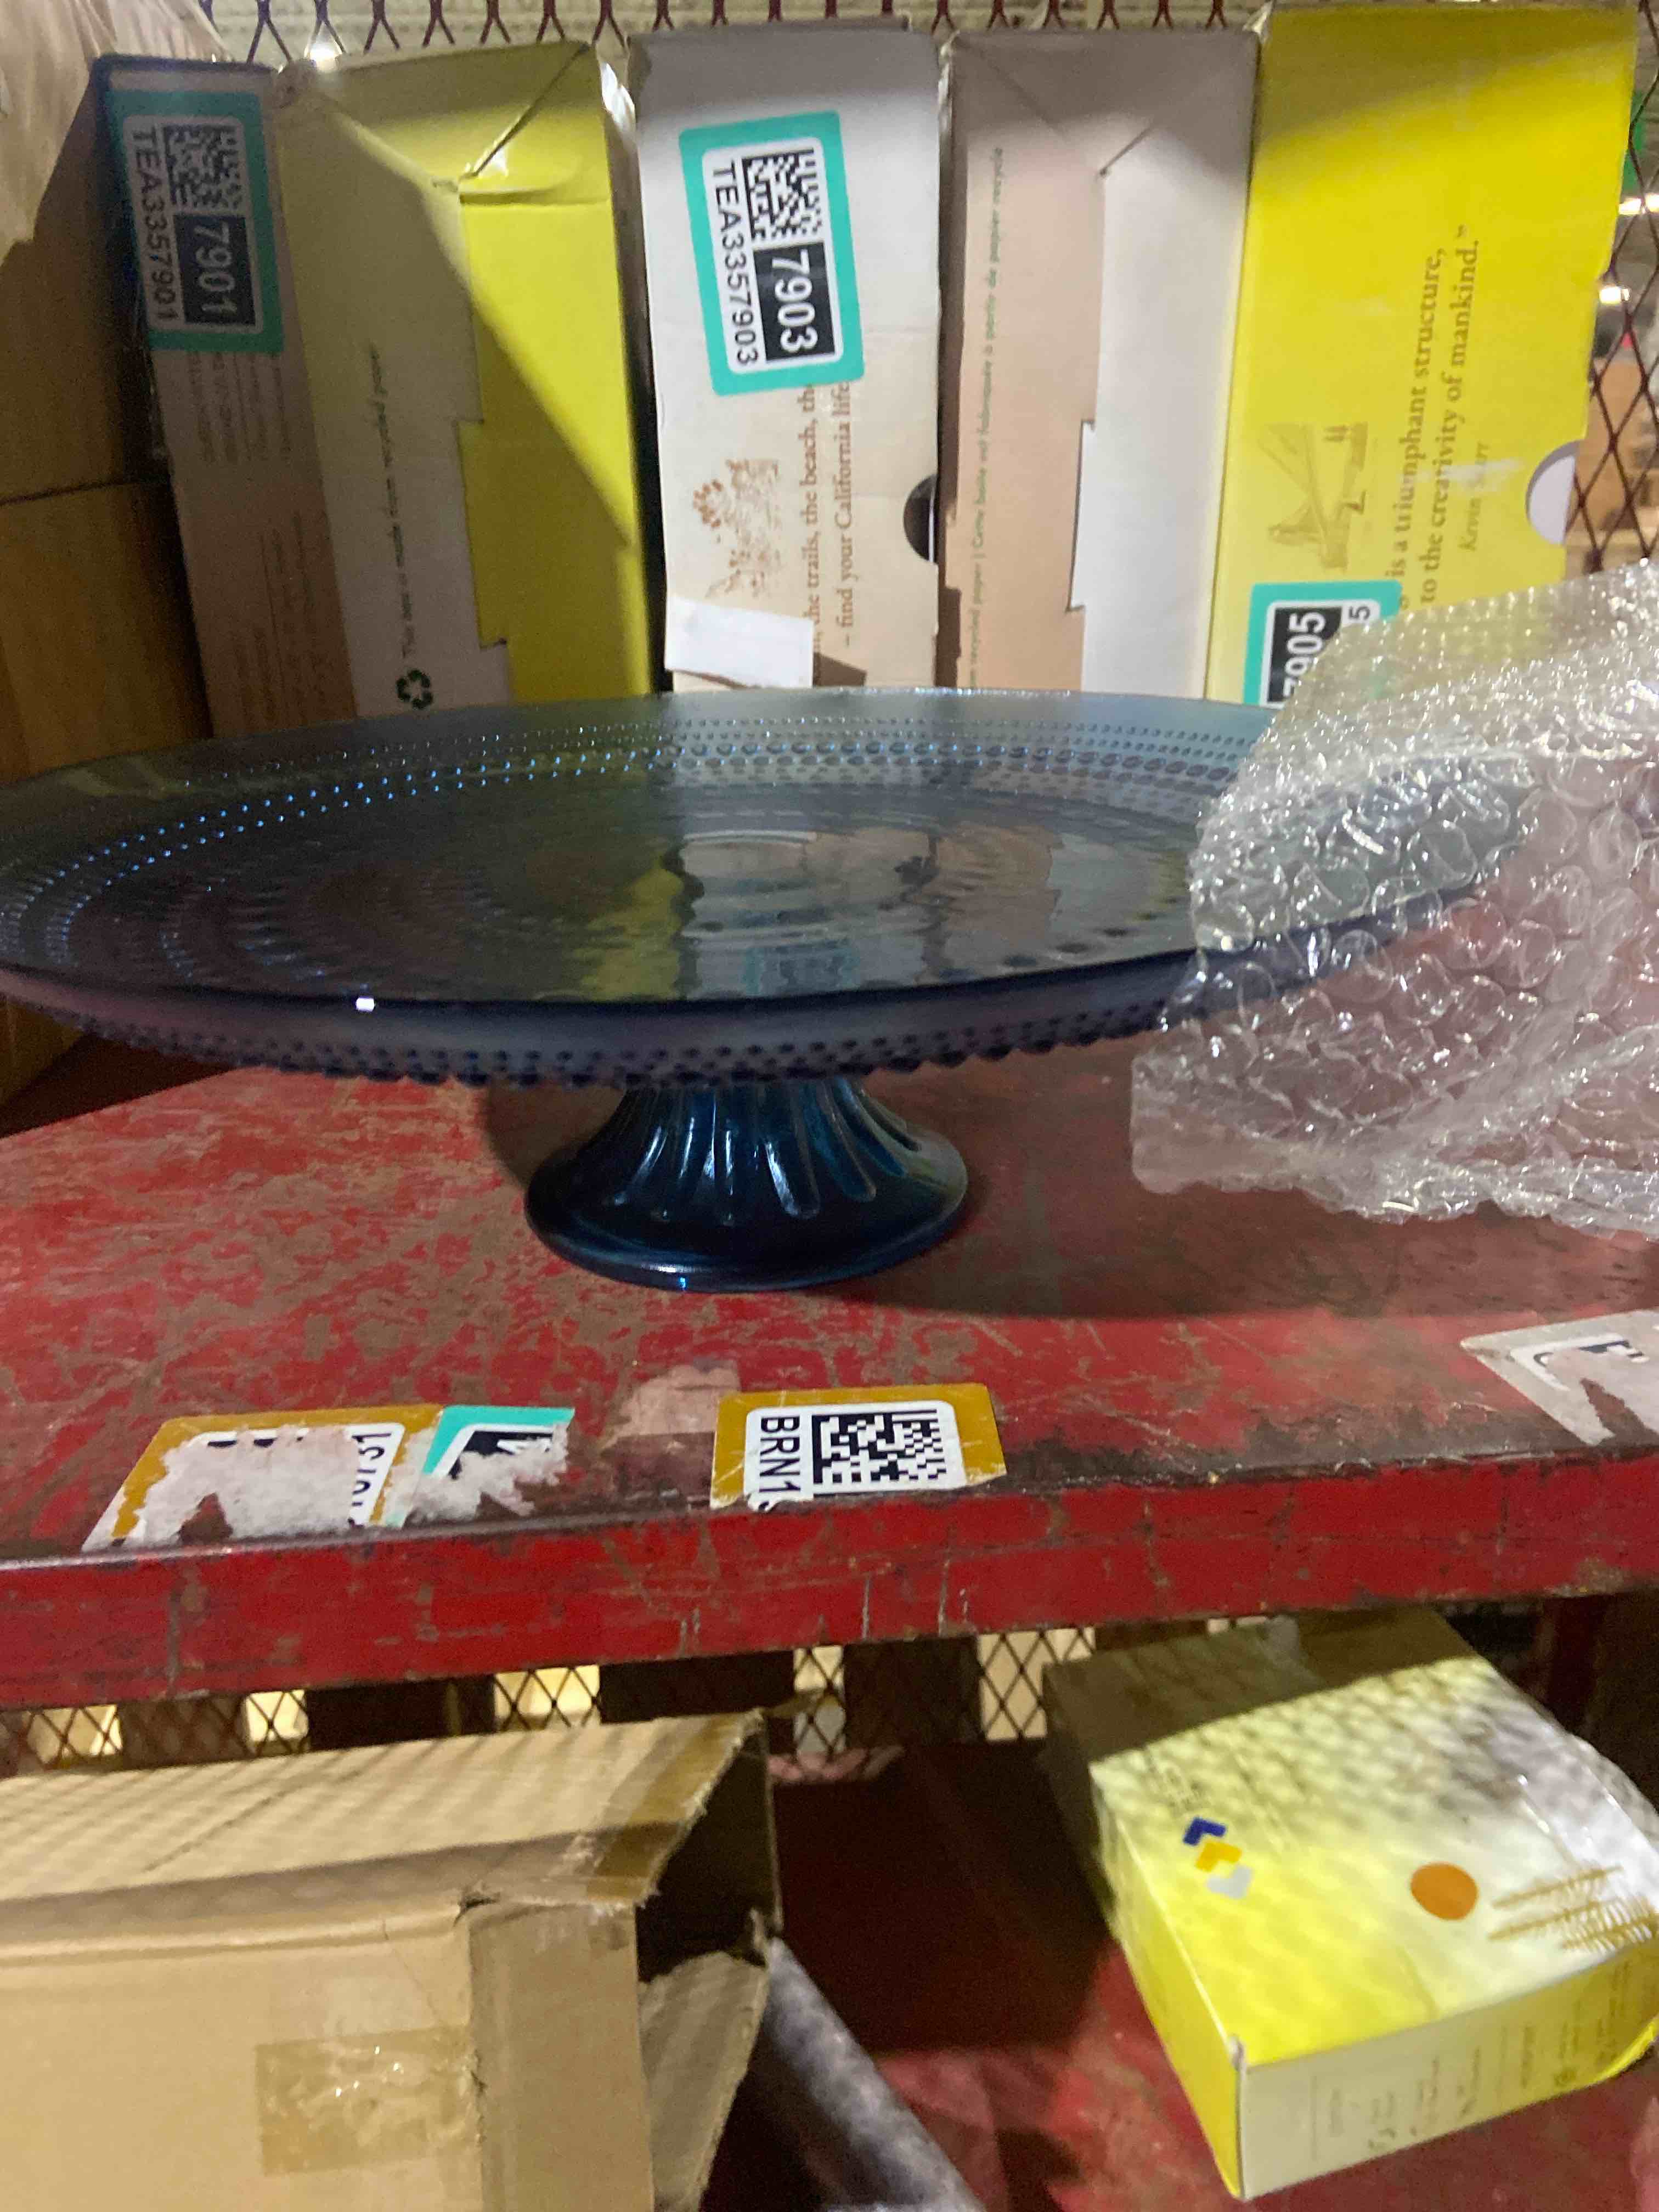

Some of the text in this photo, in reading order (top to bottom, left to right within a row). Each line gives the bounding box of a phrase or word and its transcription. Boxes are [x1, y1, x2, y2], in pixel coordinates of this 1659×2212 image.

[133, 128, 179, 321] TEA3357901
[193, 223, 237, 315] 7901
[714, 160, 759, 366] TEA3357903
[772, 249, 818, 353] 7903
[797, 384, 815, 417] th
[1385, 247, 1446, 578] is a triumphant structure,
[1442, 374, 1463, 402] of
[799, 420, 818, 486] beach,
[832, 421, 852, 529] California
[800, 491, 818, 524] the
[802, 532, 821, 588] trails,
[841, 534, 858, 582] your
[1420, 534, 1444, 571] the
[836, 588, 854, 628] find
[1420, 579, 1437, 604] to
[759, 1417, 800, 1510] BRN1
